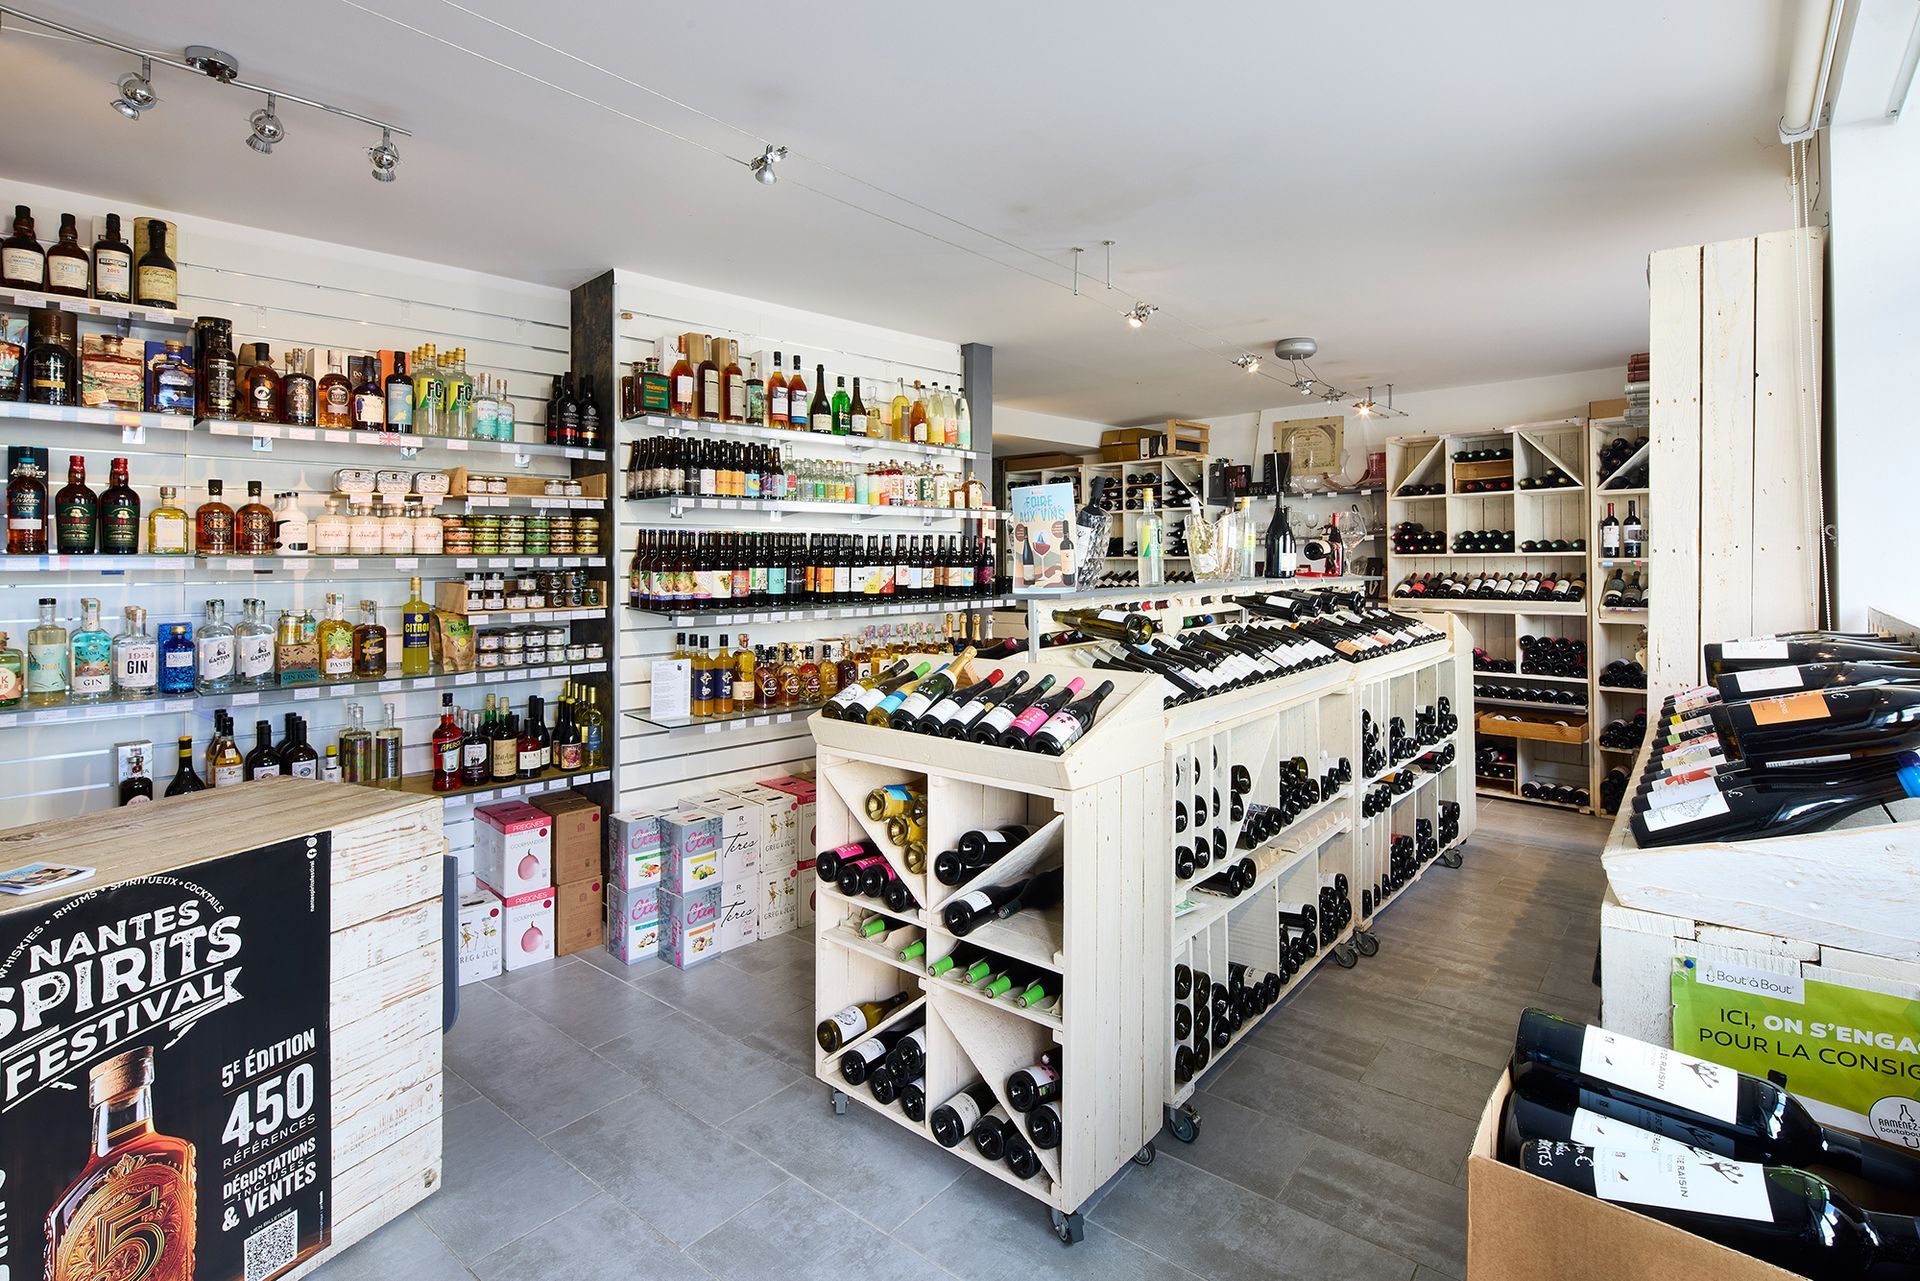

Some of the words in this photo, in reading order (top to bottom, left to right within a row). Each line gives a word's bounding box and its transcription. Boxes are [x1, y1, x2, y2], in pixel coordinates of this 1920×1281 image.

[127, 660, 149, 675] GIN
[52, 890, 98, 920] RHUMS
[109, 876, 179, 891] SPIRITUEUX
[184, 881, 225, 914] COCKTAILS
[29, 899, 200, 974] NANTES
[458, 953, 476, 965] REG
[5, 972, 225, 1102] FESTIVAL
[244, 1027, 316, 1079] ÉDITION
[1699, 1027, 1768, 1054] POUR
[1776, 1040, 1811, 1061] LA
[1720, 1007, 1756, 1030] ICI,
[1763, 1014, 1803, 1035] ON
[1809, 1021, 1920, 1055] S'ENGA
[1658, 1060, 1667, 1090] RAISIN
[221, 1062, 315, 1148] 450
[222, 1113, 317, 1170] RÉFÉRENCES
[223, 1136, 317, 1201] DÉGUSTATIONS
[236, 1158, 305, 1202] INCLUSES
[1677, 1164, 1689, 1198] RAISIN
[221, 1206, 241, 1232] &
[244, 1160, 317, 1219] VENTES
